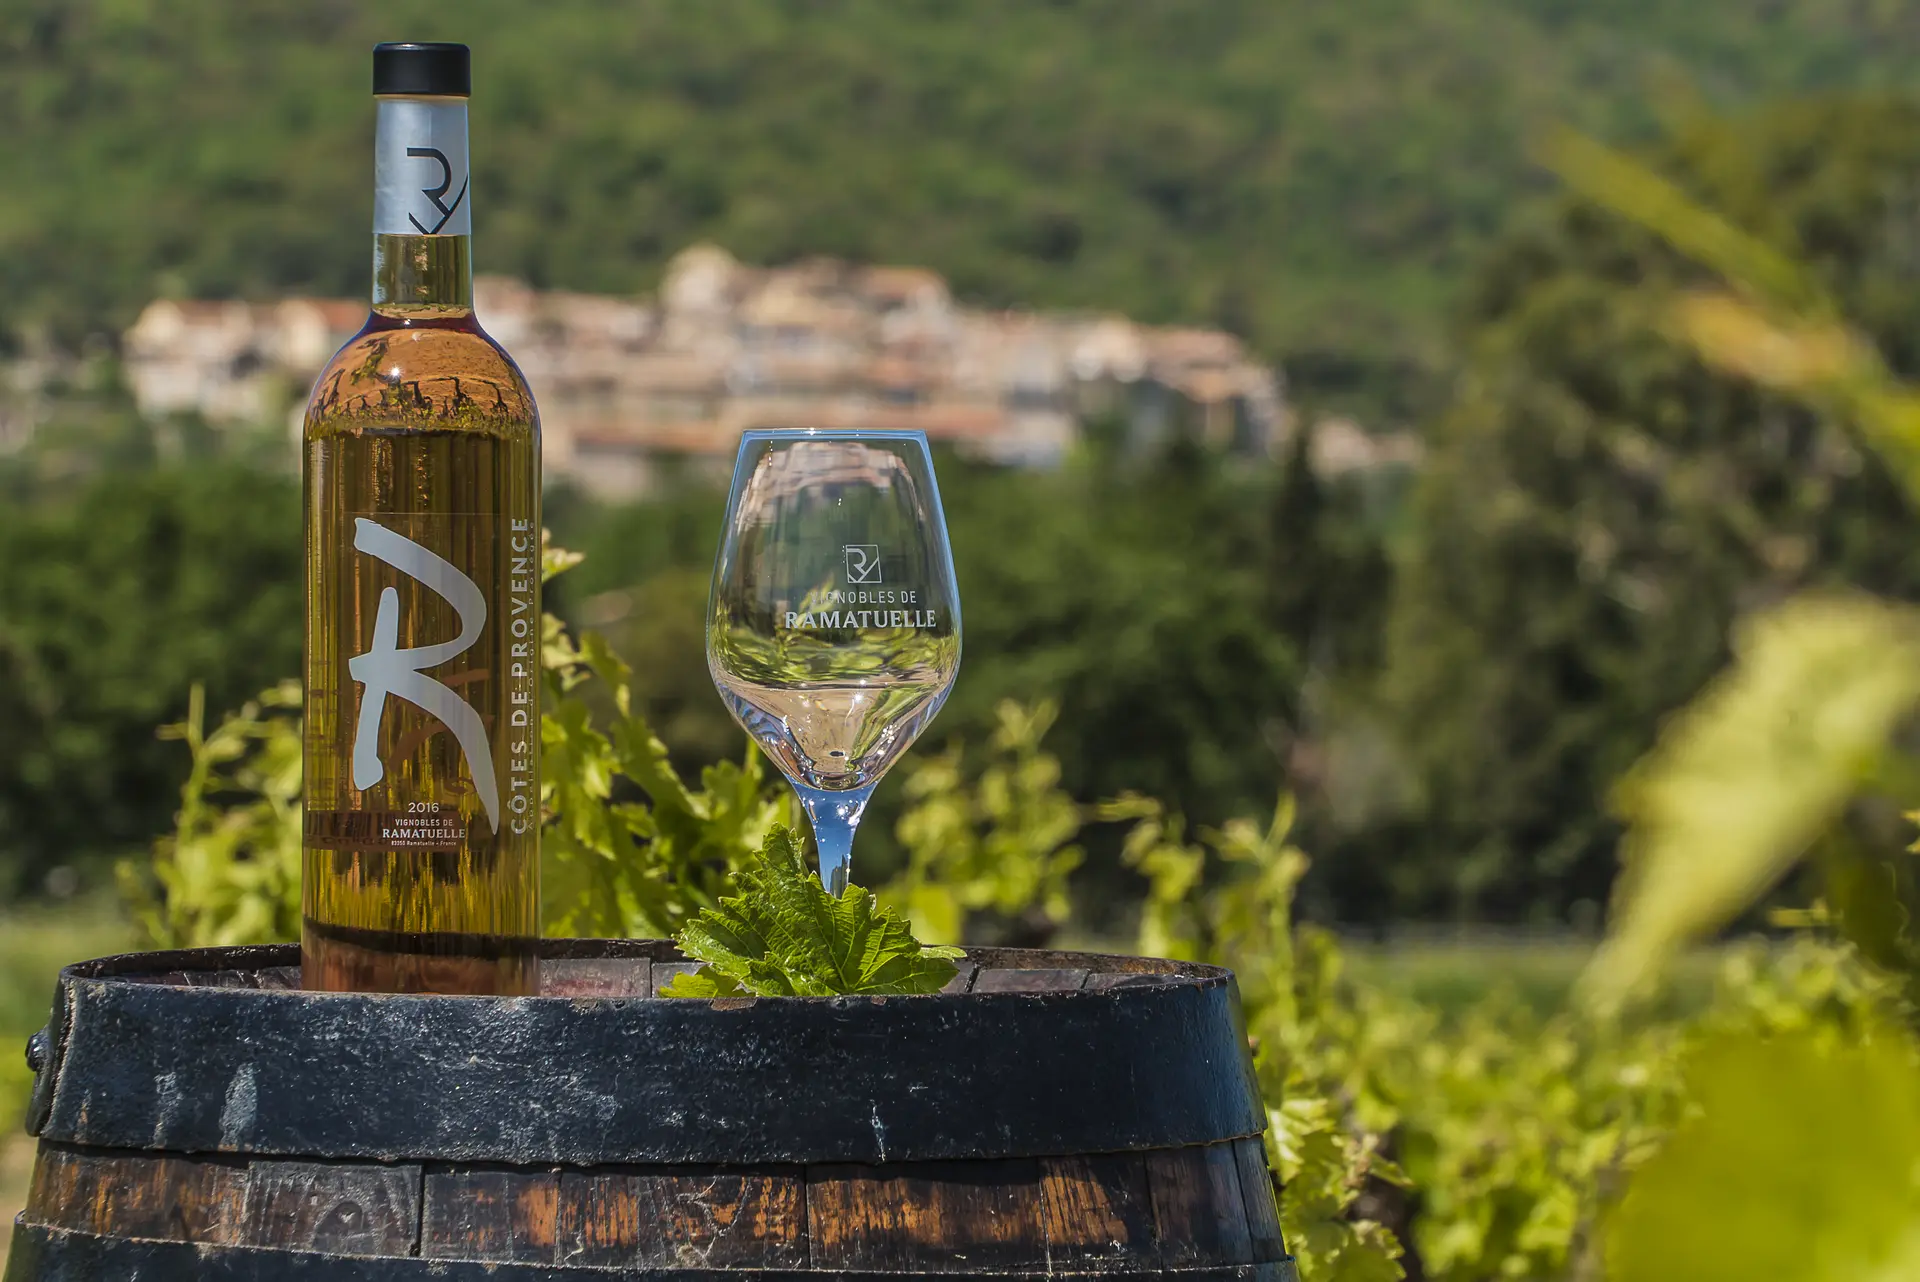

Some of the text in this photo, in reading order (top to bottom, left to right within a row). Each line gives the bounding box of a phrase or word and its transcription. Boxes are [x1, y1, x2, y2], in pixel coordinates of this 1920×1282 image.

[811, 591, 917, 604] VIGNOBLES DE
[785, 610, 937, 629] RAMATUELLE
[507, 518, 528, 834] CÔTES DE PROVENCE
[408, 802, 439, 813] 2016
[395, 818, 453, 827] VIGNOBLES DE
[382, 828, 465, 839] RAMATUELLE
